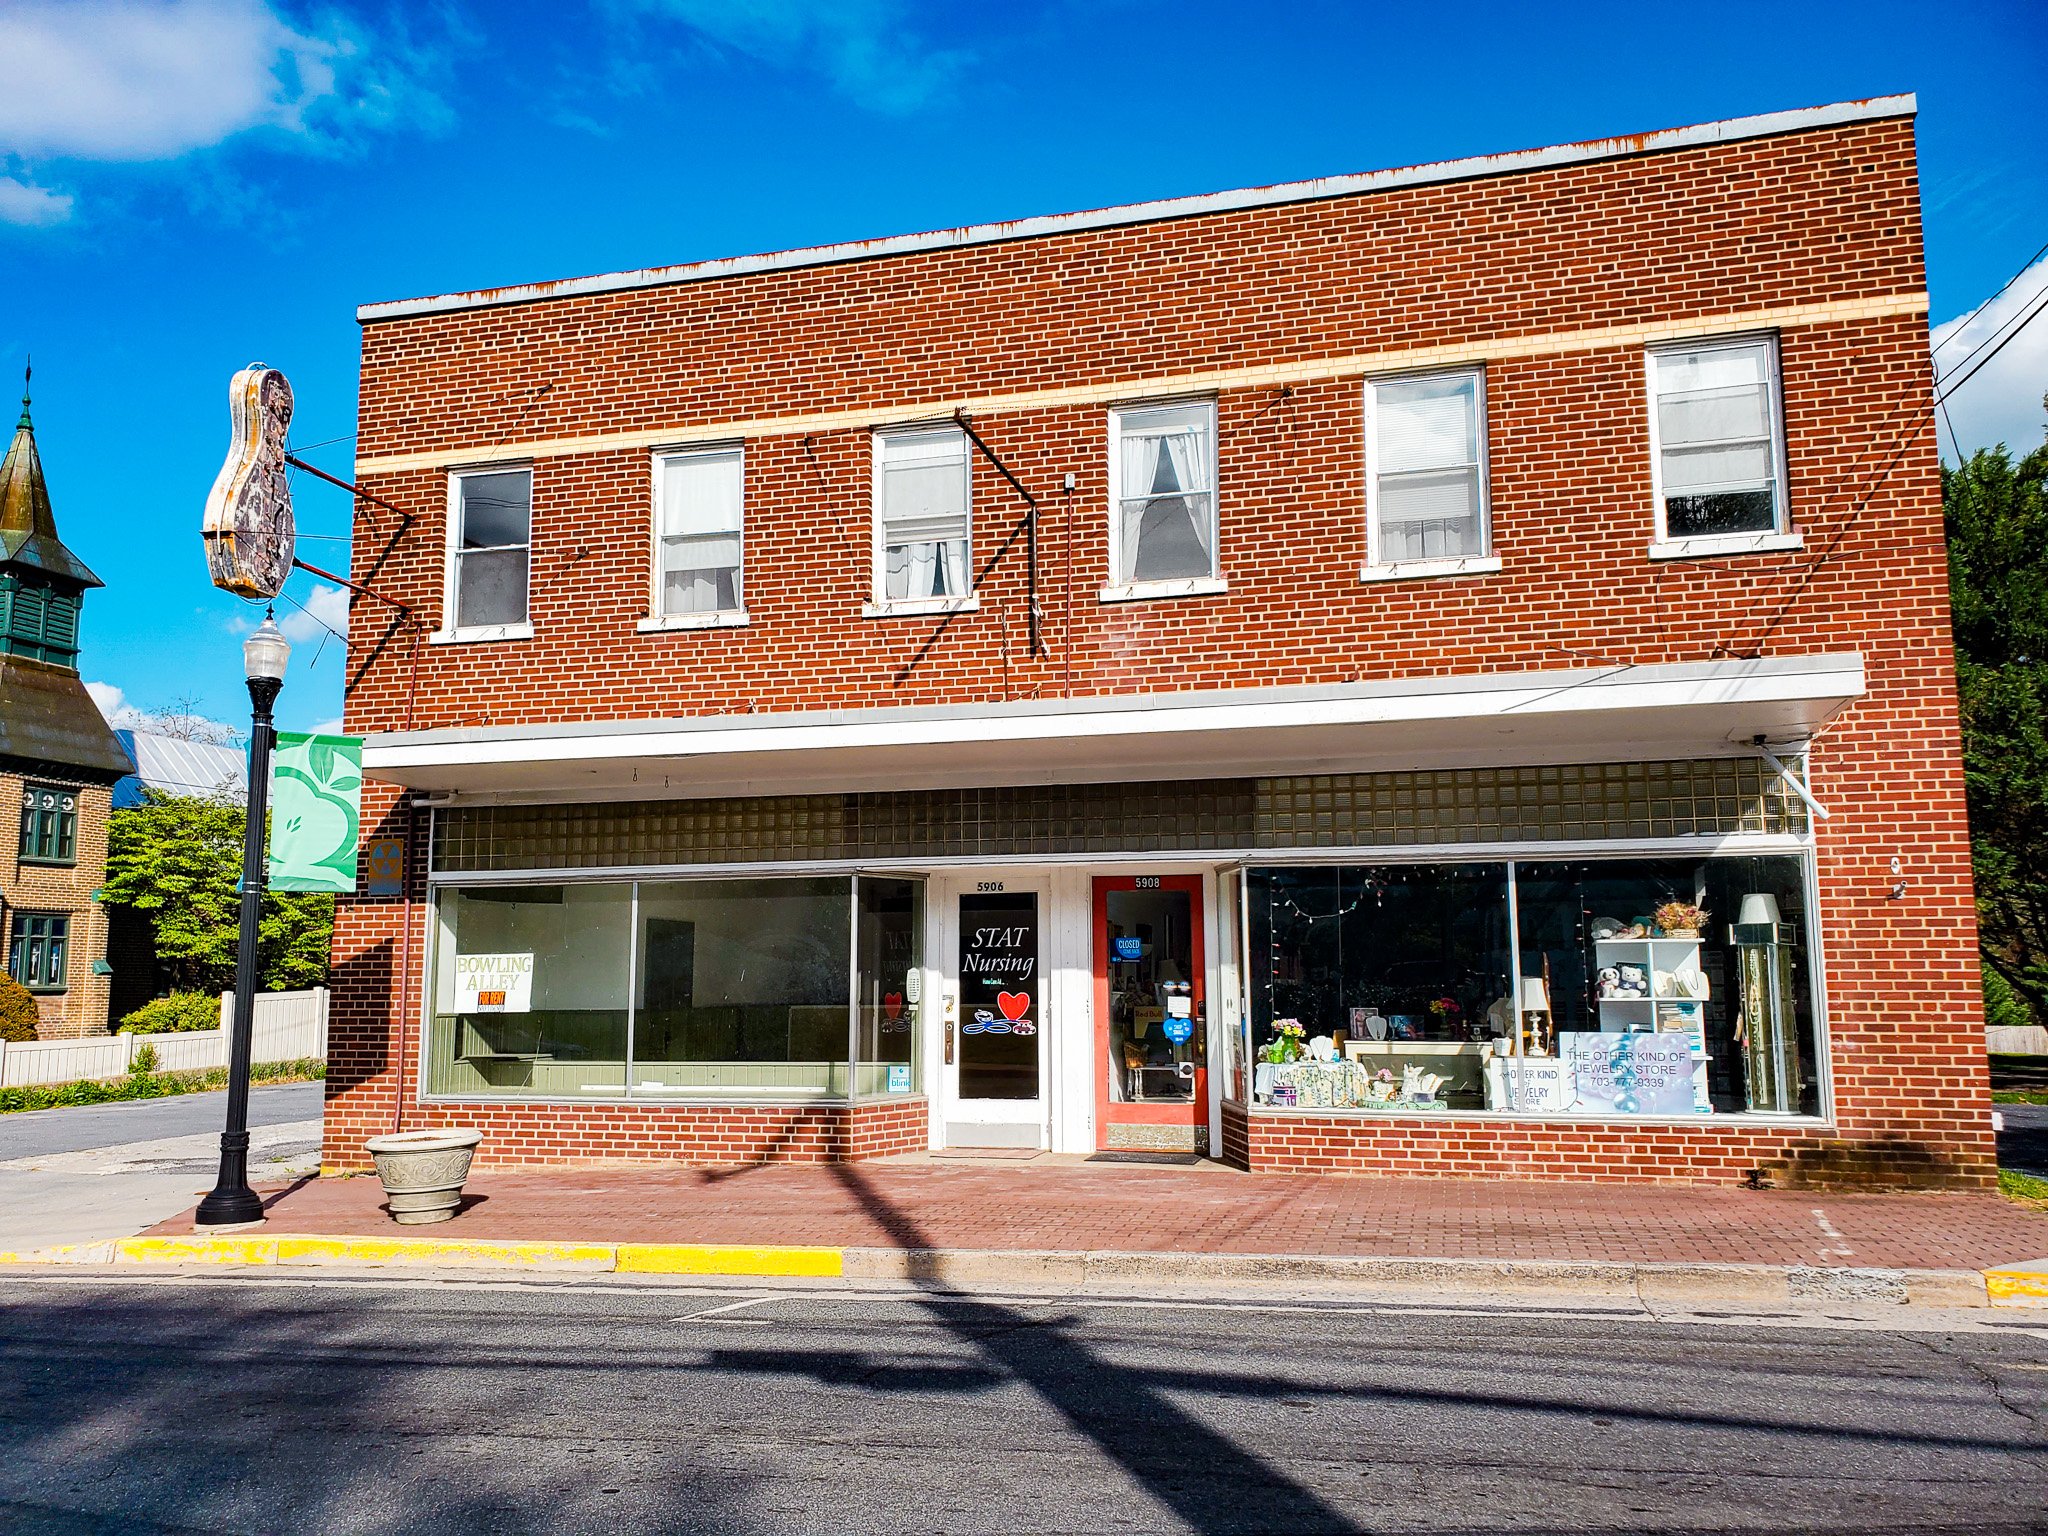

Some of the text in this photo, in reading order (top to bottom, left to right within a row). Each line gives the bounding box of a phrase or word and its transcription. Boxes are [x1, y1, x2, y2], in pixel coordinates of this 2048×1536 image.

[977, 882, 1004, 892] 5906
[1135, 877, 1160, 888] 5908
[971, 927, 1030, 948] STAT
[1118, 939, 1140, 949] CLOSED
[457, 956, 532, 973] BOWLING
[961, 953, 1035, 981] Nursing
[465, 974, 520, 991] ALLEY
[479, 992, 505, 1005] FOR RENT
[1567, 1051, 1686, 1062] THE OTHER KIND OF
[1510, 1069, 1536, 1079] OER
[1537, 1070, 1558, 1080] KIND
[1576, 1064, 1677, 1075] JEWELRY STORE
[891, 1078, 910, 1087] blink
[1590, 1076, 1665, 1088] 703-777-9339
[1514, 1098, 1541, 1106] SORE
